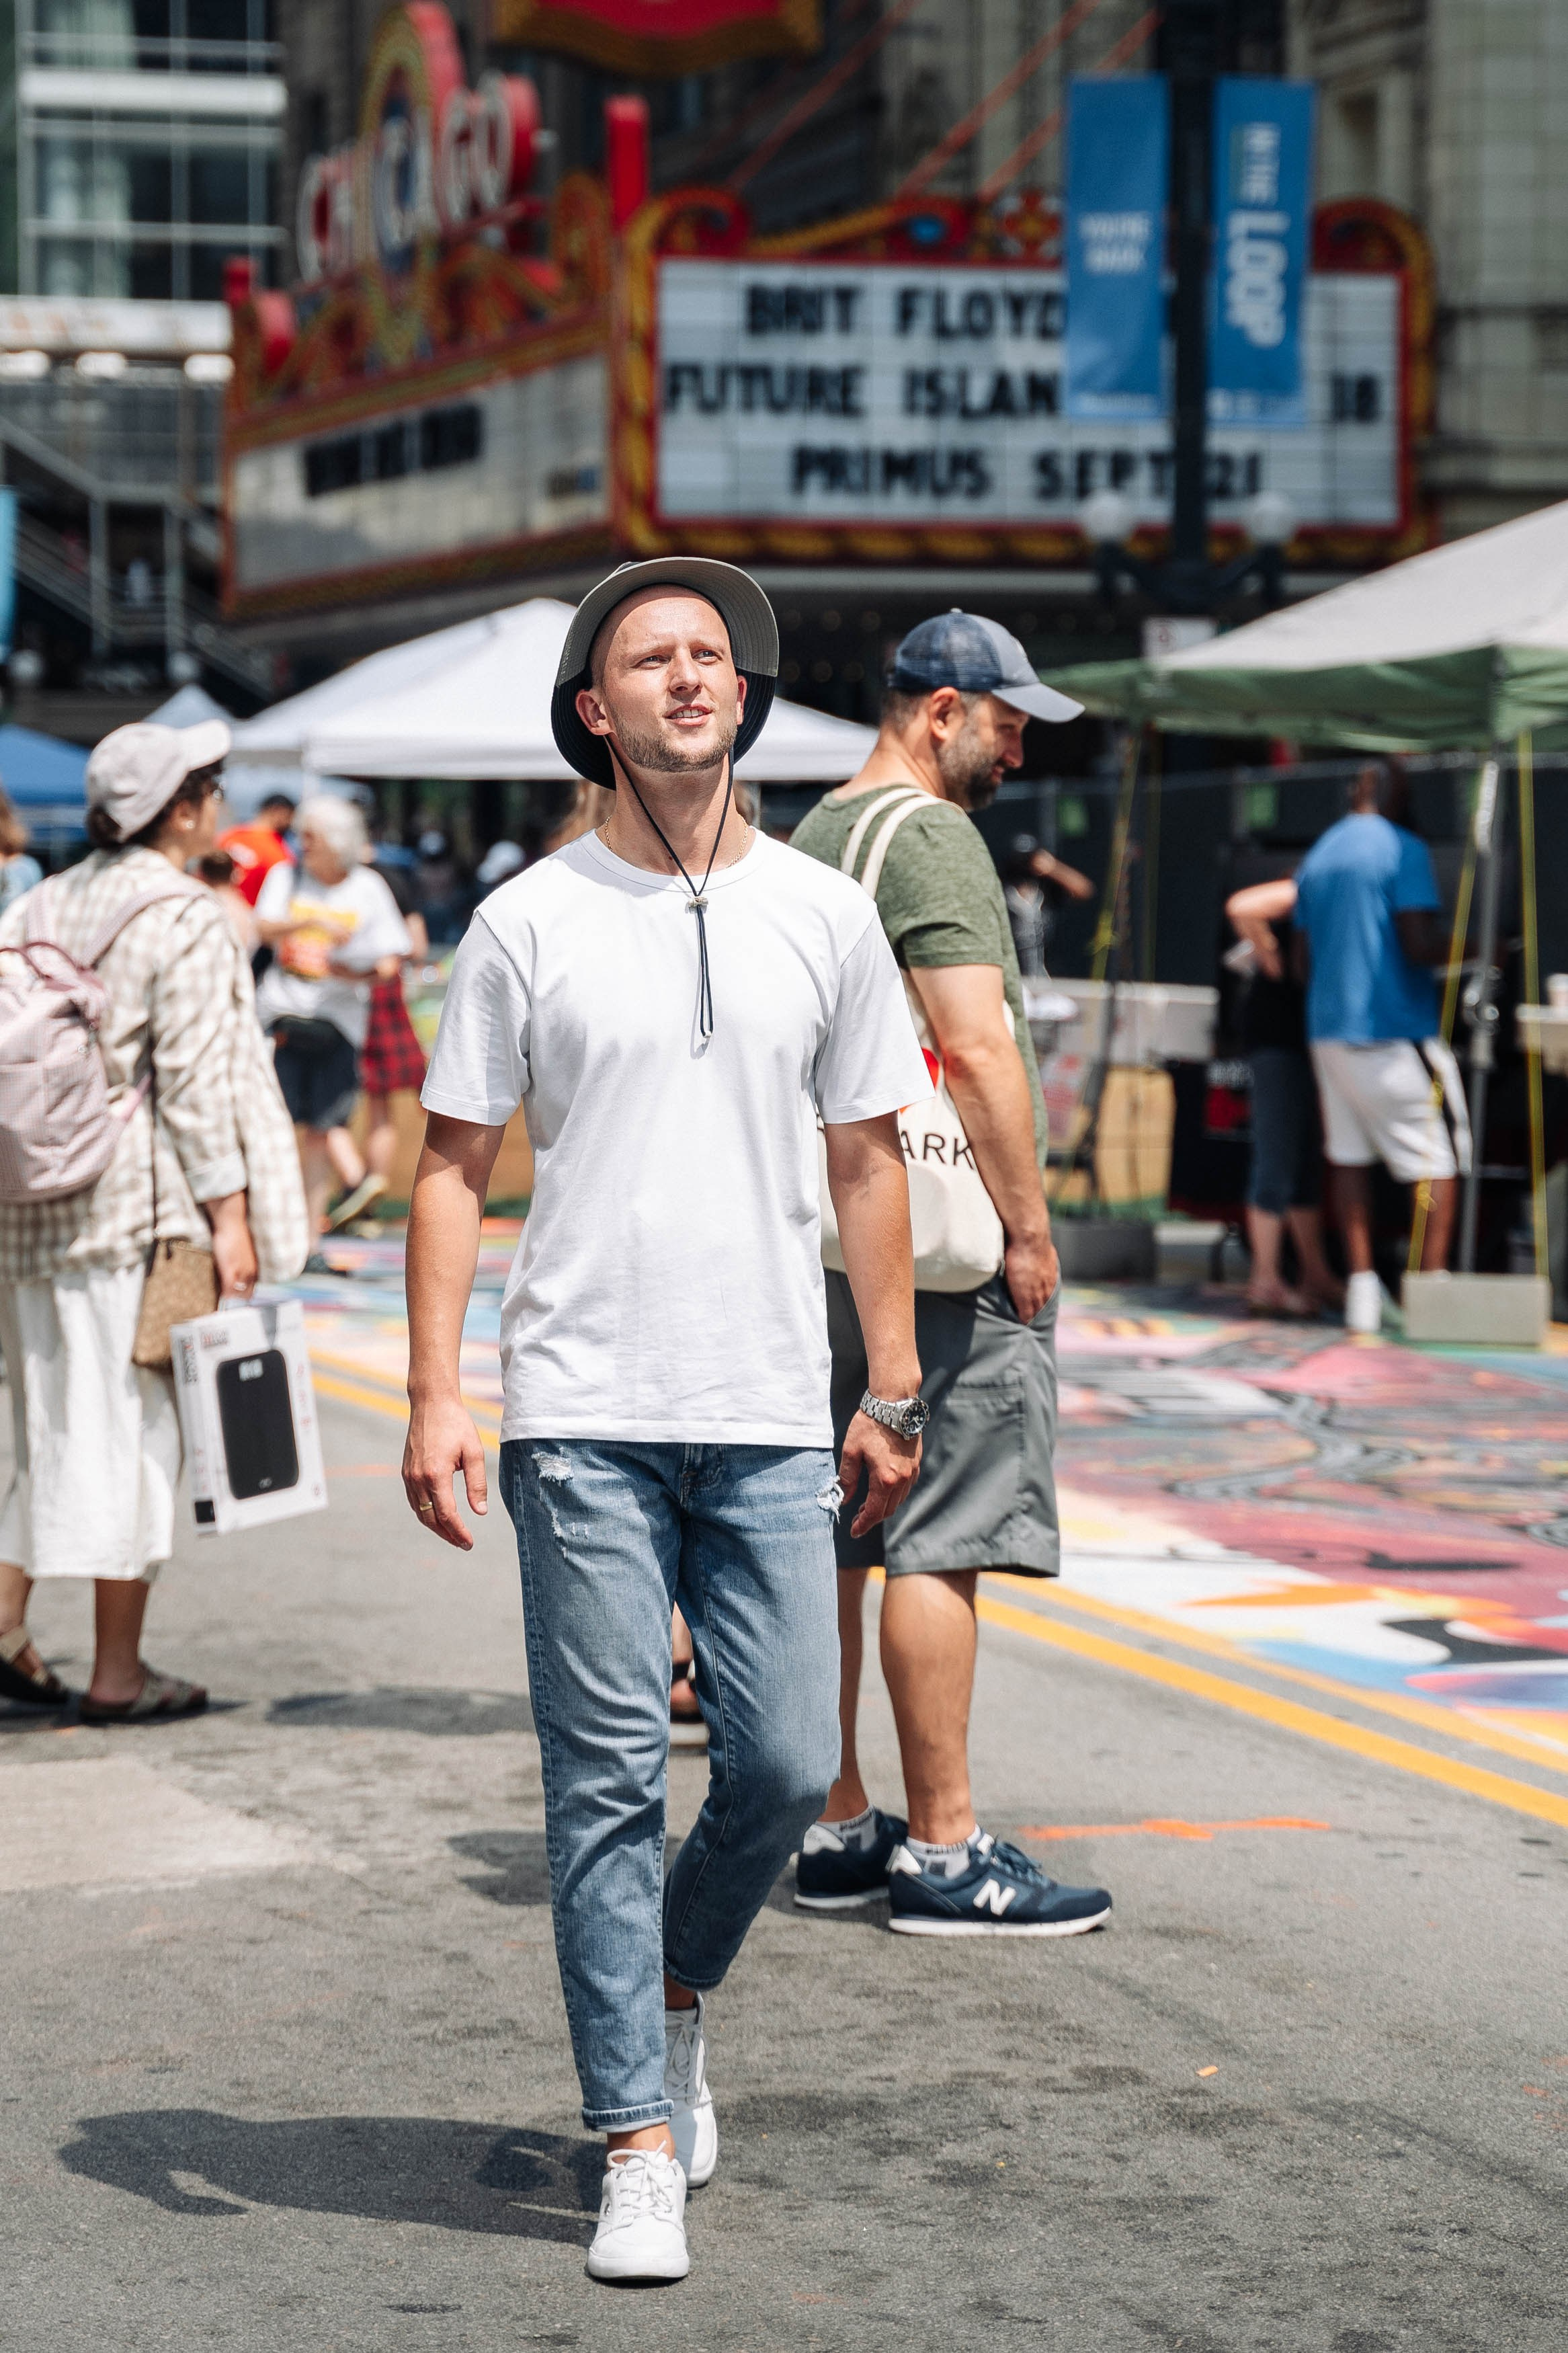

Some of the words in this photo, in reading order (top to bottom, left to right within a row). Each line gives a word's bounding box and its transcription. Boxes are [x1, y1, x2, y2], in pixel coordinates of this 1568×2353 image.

[1226, 210, 1291, 348] LOOP
[745, 284, 861, 336] BRIT
[663, 363, 863, 415] FUTURE
[793, 446, 991, 500] PRIMUS
[1034, 449, 1174, 502] SEPT
